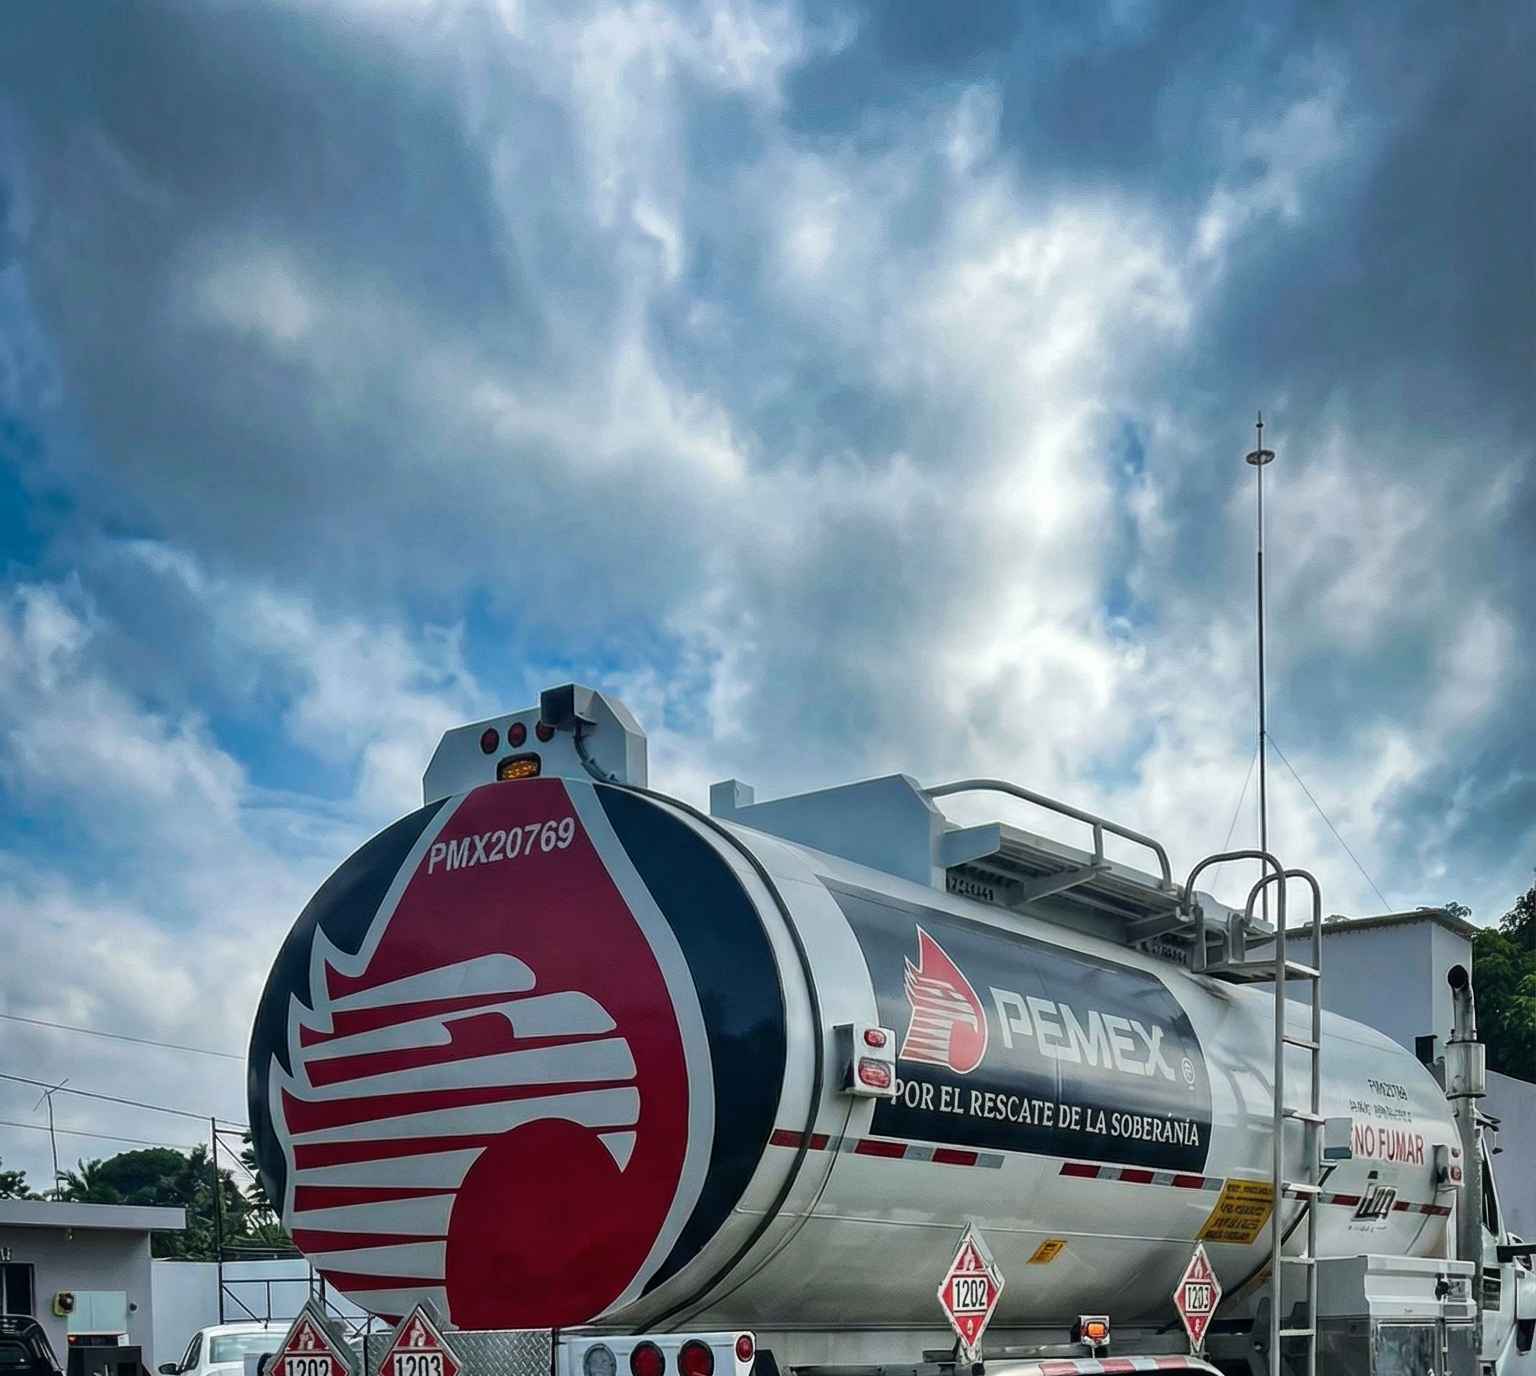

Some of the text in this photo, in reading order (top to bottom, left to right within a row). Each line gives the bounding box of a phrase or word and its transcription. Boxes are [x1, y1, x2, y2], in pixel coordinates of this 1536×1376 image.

[427, 816, 576, 875] PMX20769
[988, 985, 1177, 1082] PEMEX
[890, 1078, 935, 1111] POR
[939, 1085, 965, 1115] EL
[969, 1089, 1054, 1128] RESCATE
[1058, 1103, 1082, 1131] DE
[1085, 1107, 1108, 1135] LA
[1354, 1124, 1425, 1166] NO FUMAR
[955, 1279, 987, 1308] 1202
